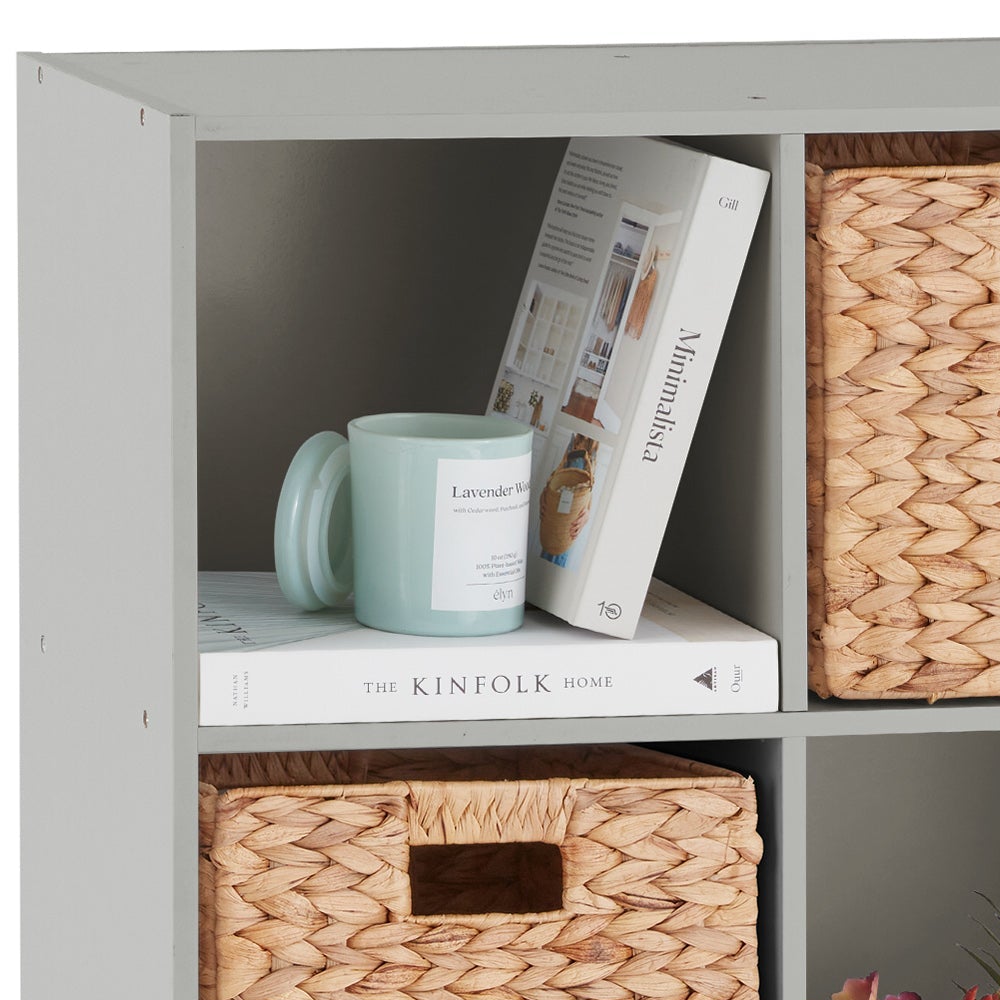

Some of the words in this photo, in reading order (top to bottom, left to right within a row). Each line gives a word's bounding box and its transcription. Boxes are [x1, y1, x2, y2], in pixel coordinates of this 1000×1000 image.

[718, 195, 740, 212] Gill
[641, 327, 701, 463] Minimalista
[452, 485, 514, 498] Lavender
[363, 682, 398, 693] THE
[412, 674, 552, 695] KINFOLK
[563, 676, 614, 689] HOME
